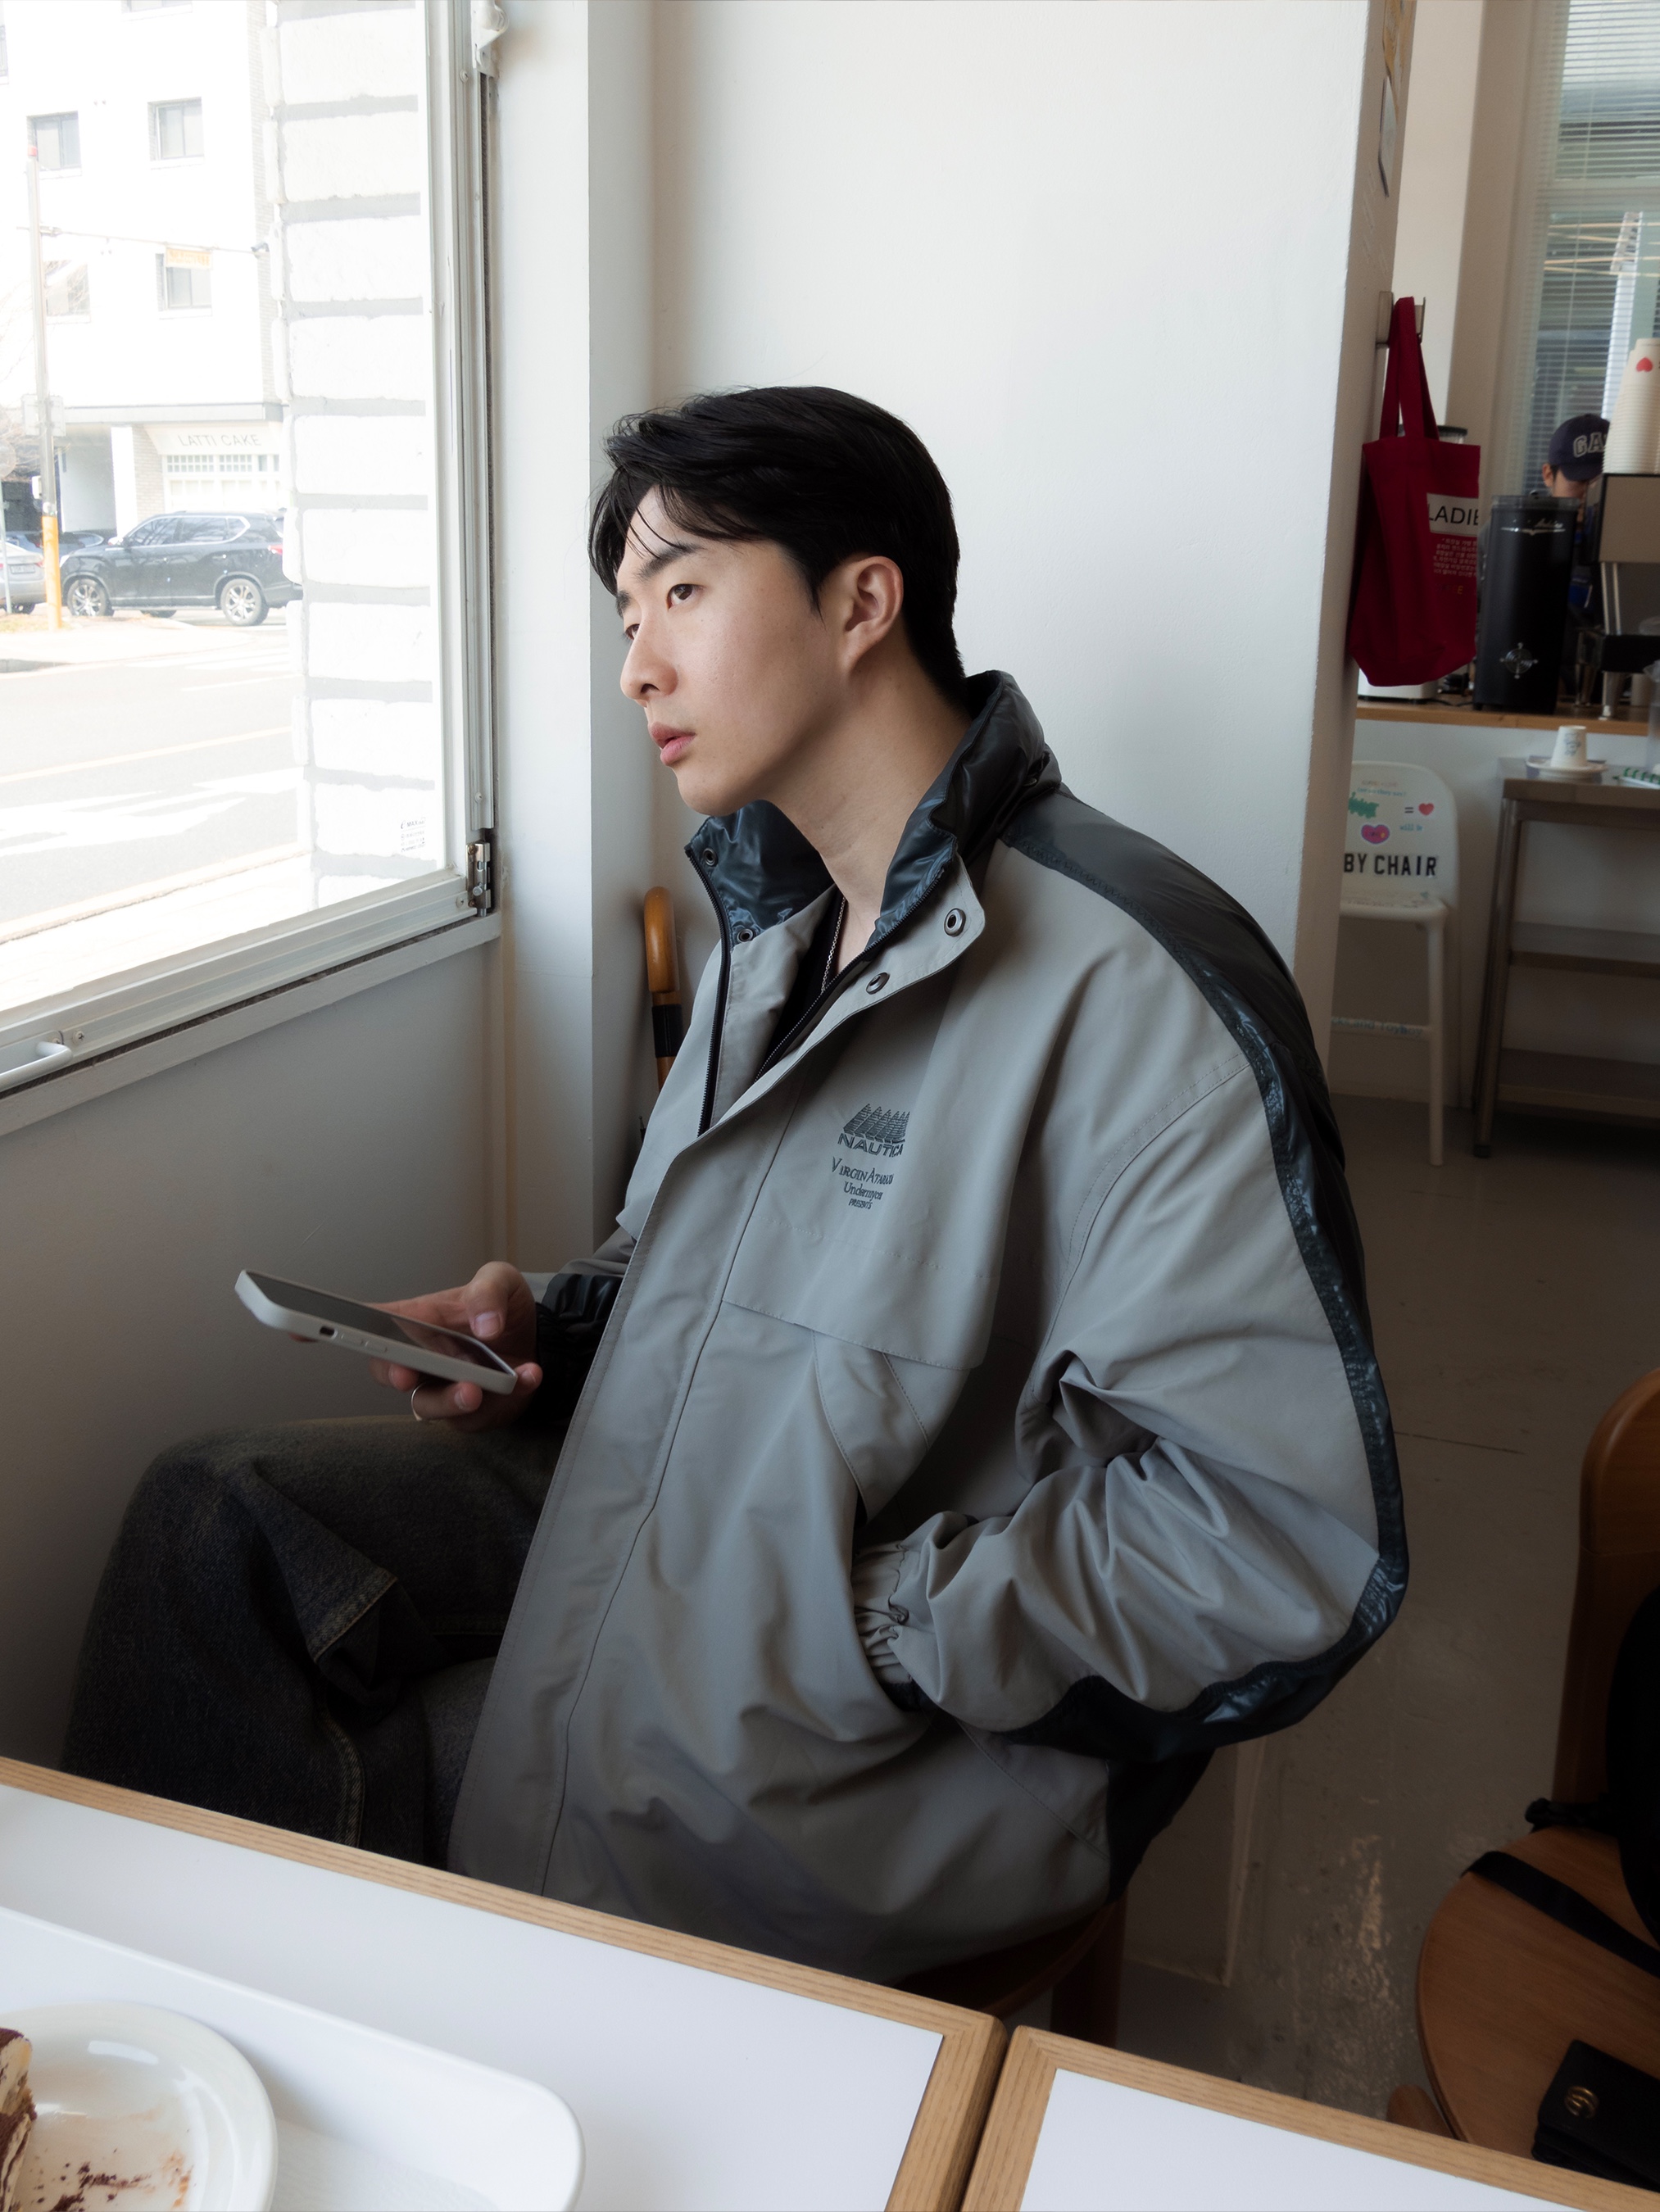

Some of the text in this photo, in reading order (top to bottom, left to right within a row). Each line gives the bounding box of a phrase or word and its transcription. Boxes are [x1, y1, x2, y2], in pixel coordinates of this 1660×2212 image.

[177, 434, 261, 446] LATTI CAKE
[1572, 432, 1607, 458] GA
[1344, 853, 1437, 876] BY CHAIR
[837, 1133, 904, 1158] NAUTICA
